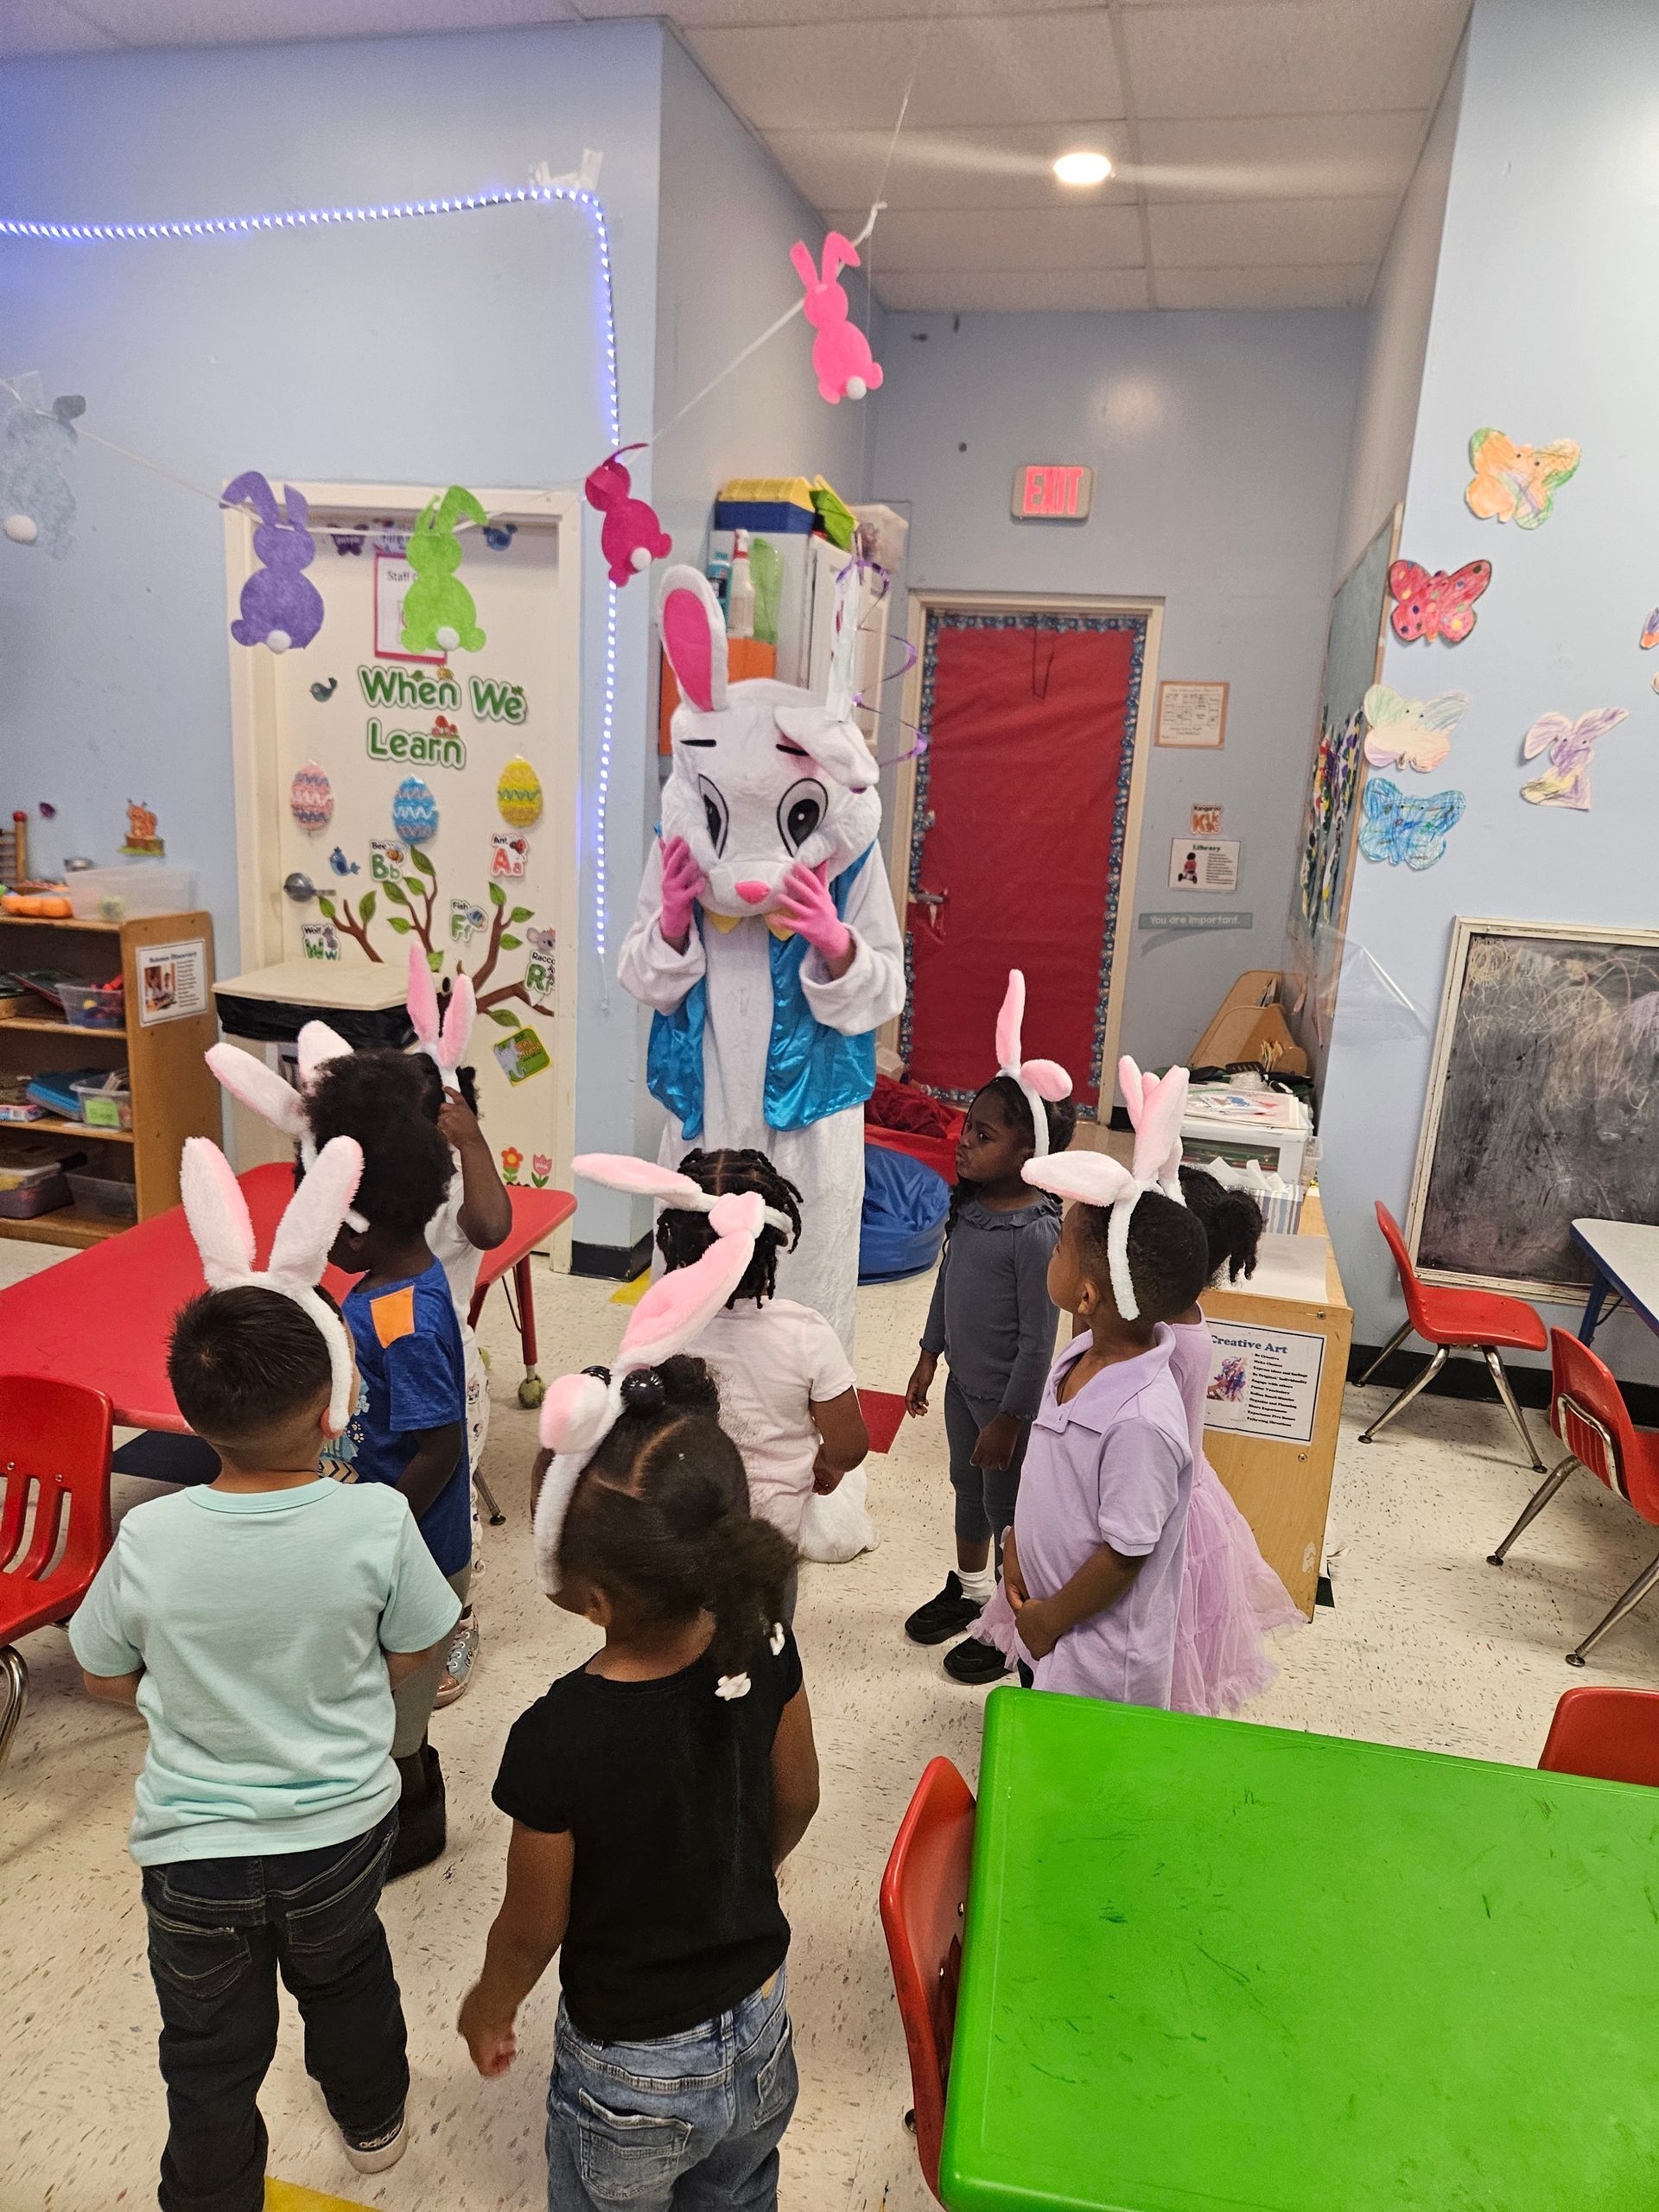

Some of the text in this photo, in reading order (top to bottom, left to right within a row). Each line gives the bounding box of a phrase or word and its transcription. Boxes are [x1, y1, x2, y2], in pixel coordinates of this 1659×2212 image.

[1023, 466, 1084, 515] EXIT
[387, 570, 410, 582] Staff
[359, 668, 525, 721] When We
[370, 721, 464, 766] Learn
[493, 836, 508, 844] Ant
[372, 854, 401, 880] Bb
[493, 847, 523, 874] Aa
[453, 900, 468, 910] Fish
[451, 914, 472, 939] Ff
[1151, 916, 1166, 925] You
[305, 938, 338, 961] Ww
[1265, 1343, 1287, 1354] Art
[359, 2122, 401, 2149] adidas
